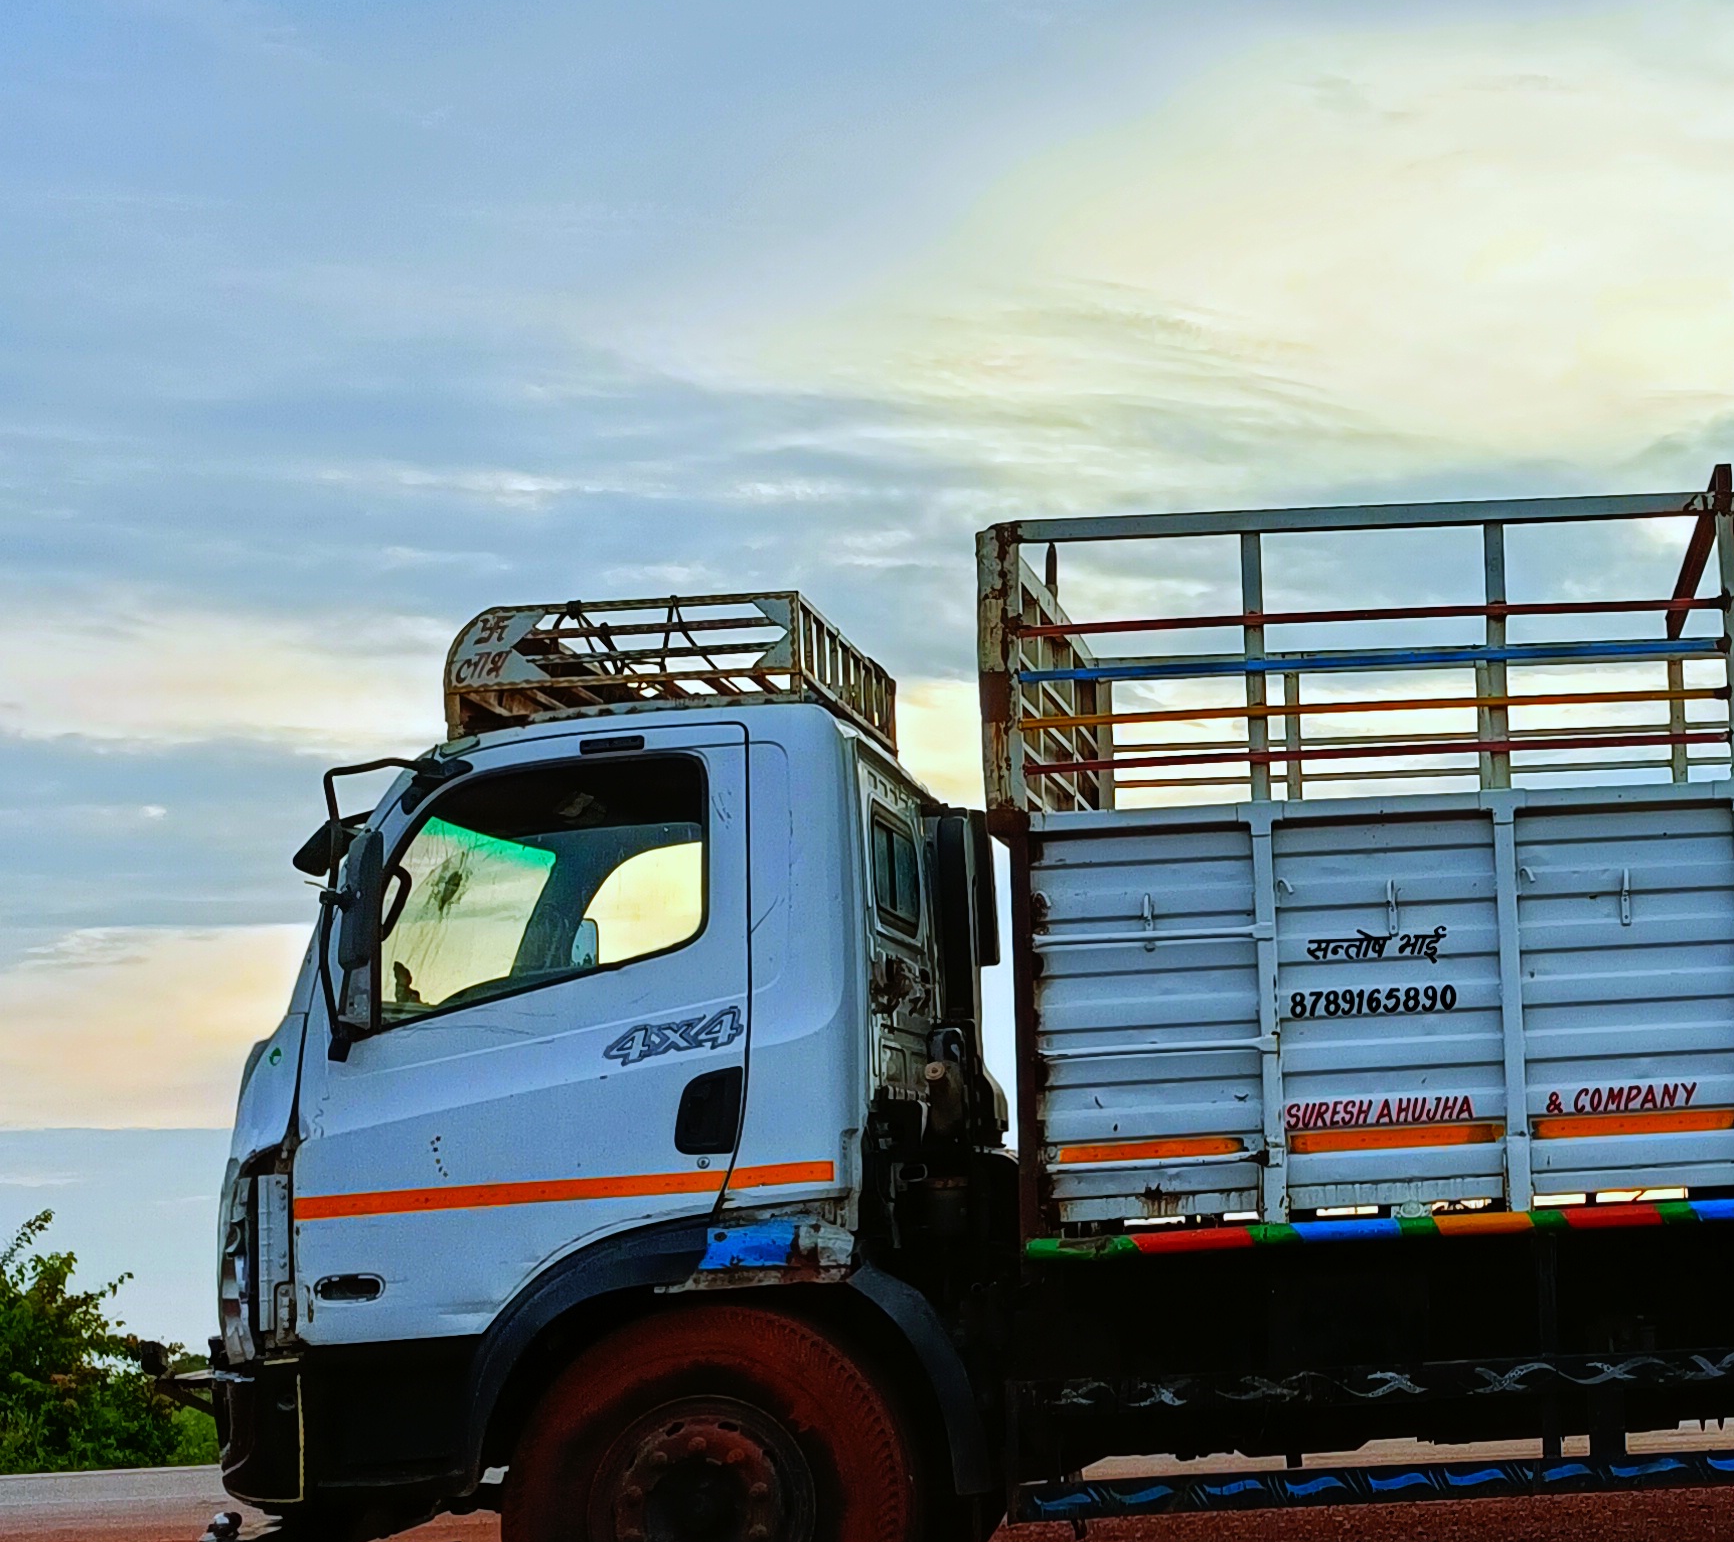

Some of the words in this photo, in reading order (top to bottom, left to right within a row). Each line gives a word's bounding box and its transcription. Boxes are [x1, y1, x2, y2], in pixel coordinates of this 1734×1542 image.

[1306, 928, 1393, 960] सन्तोष
[1398, 925, 1447, 964] भाई
[1290, 984, 1457, 1019] 8789165890
[1286, 1099, 1373, 1129] SURESH
[1375, 1095, 1474, 1124] AHUJHA
[1546, 1091, 1563, 1114] &
[1573, 1082, 1697, 1113] COMPANY
